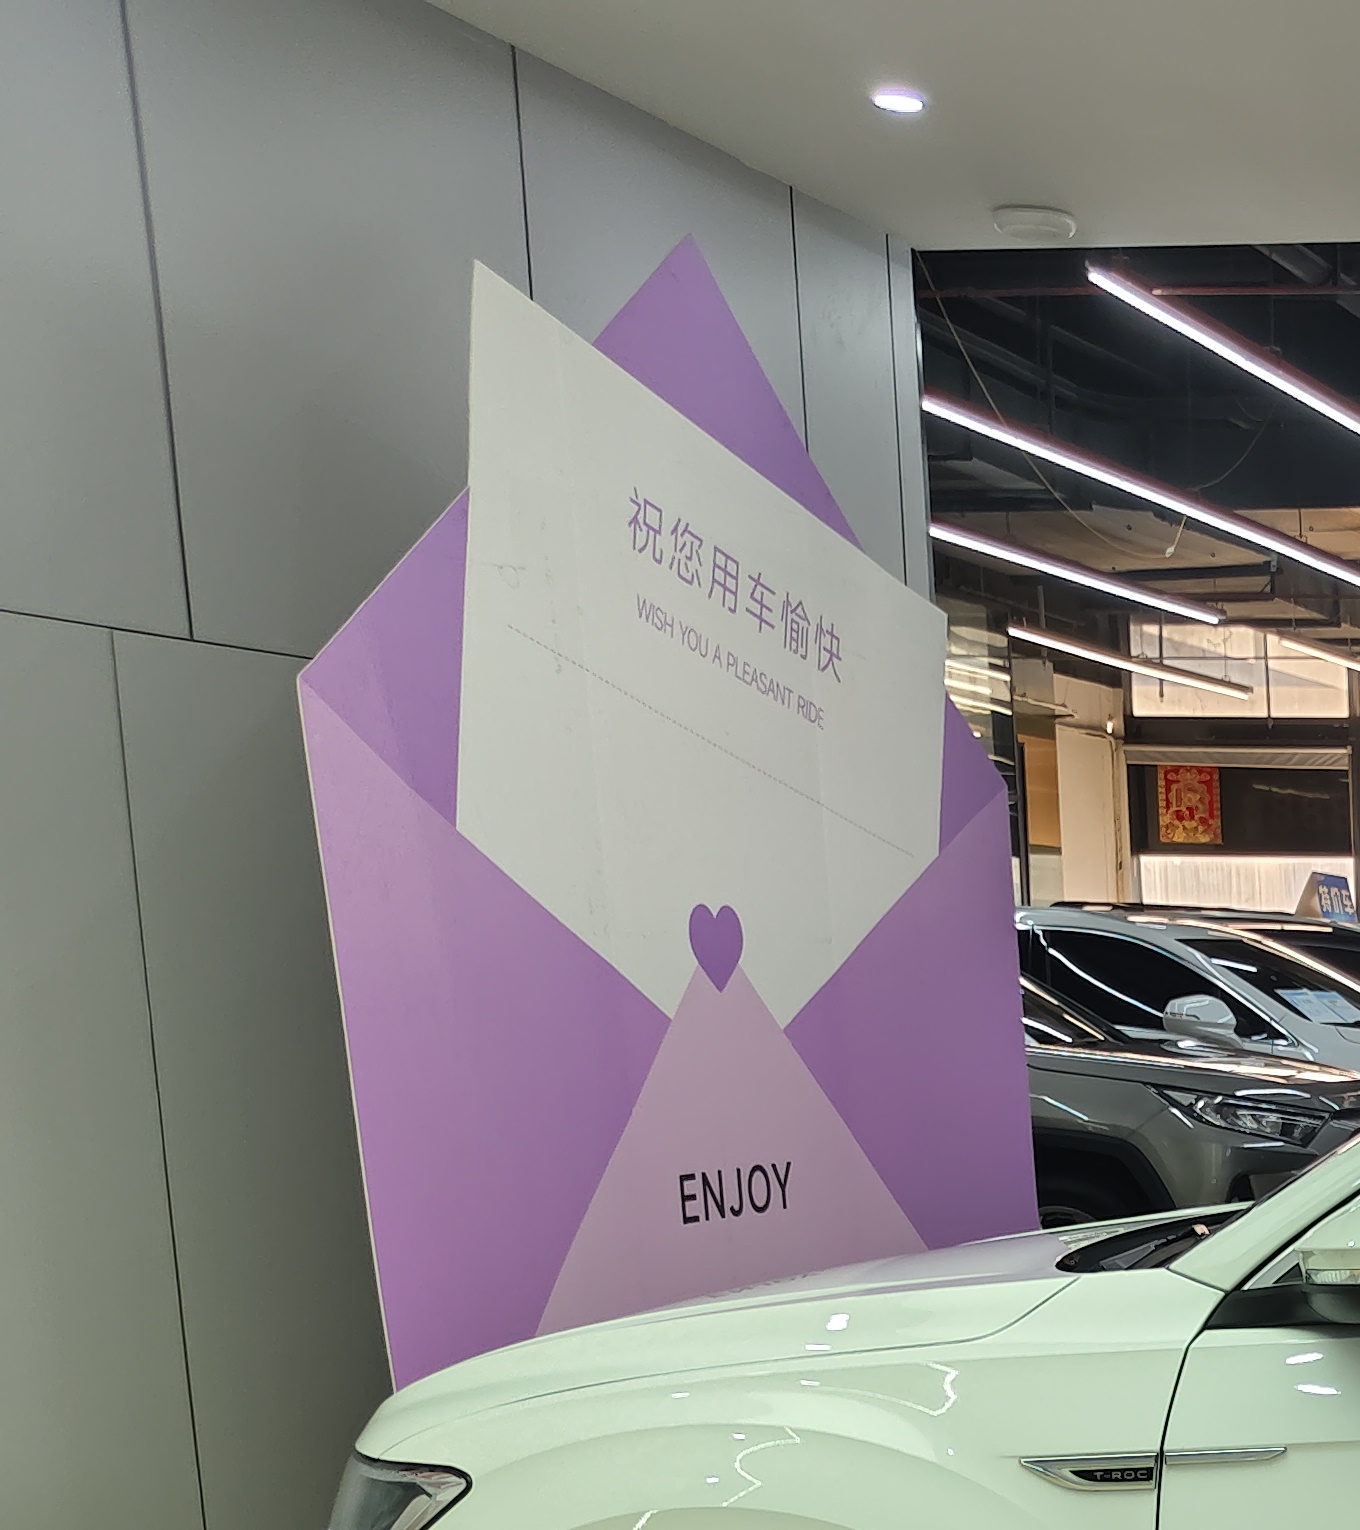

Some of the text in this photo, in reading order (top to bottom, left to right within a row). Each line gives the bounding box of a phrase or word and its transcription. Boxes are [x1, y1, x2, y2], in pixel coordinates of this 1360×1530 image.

[627, 486, 842, 684] 祝您用车愉快
[636, 592, 825, 731] WISH YOU A PLEASANT RIDE
[679, 1161, 792, 1225] ENJOY
[1093, 1470, 1148, 1480] T-ROC
